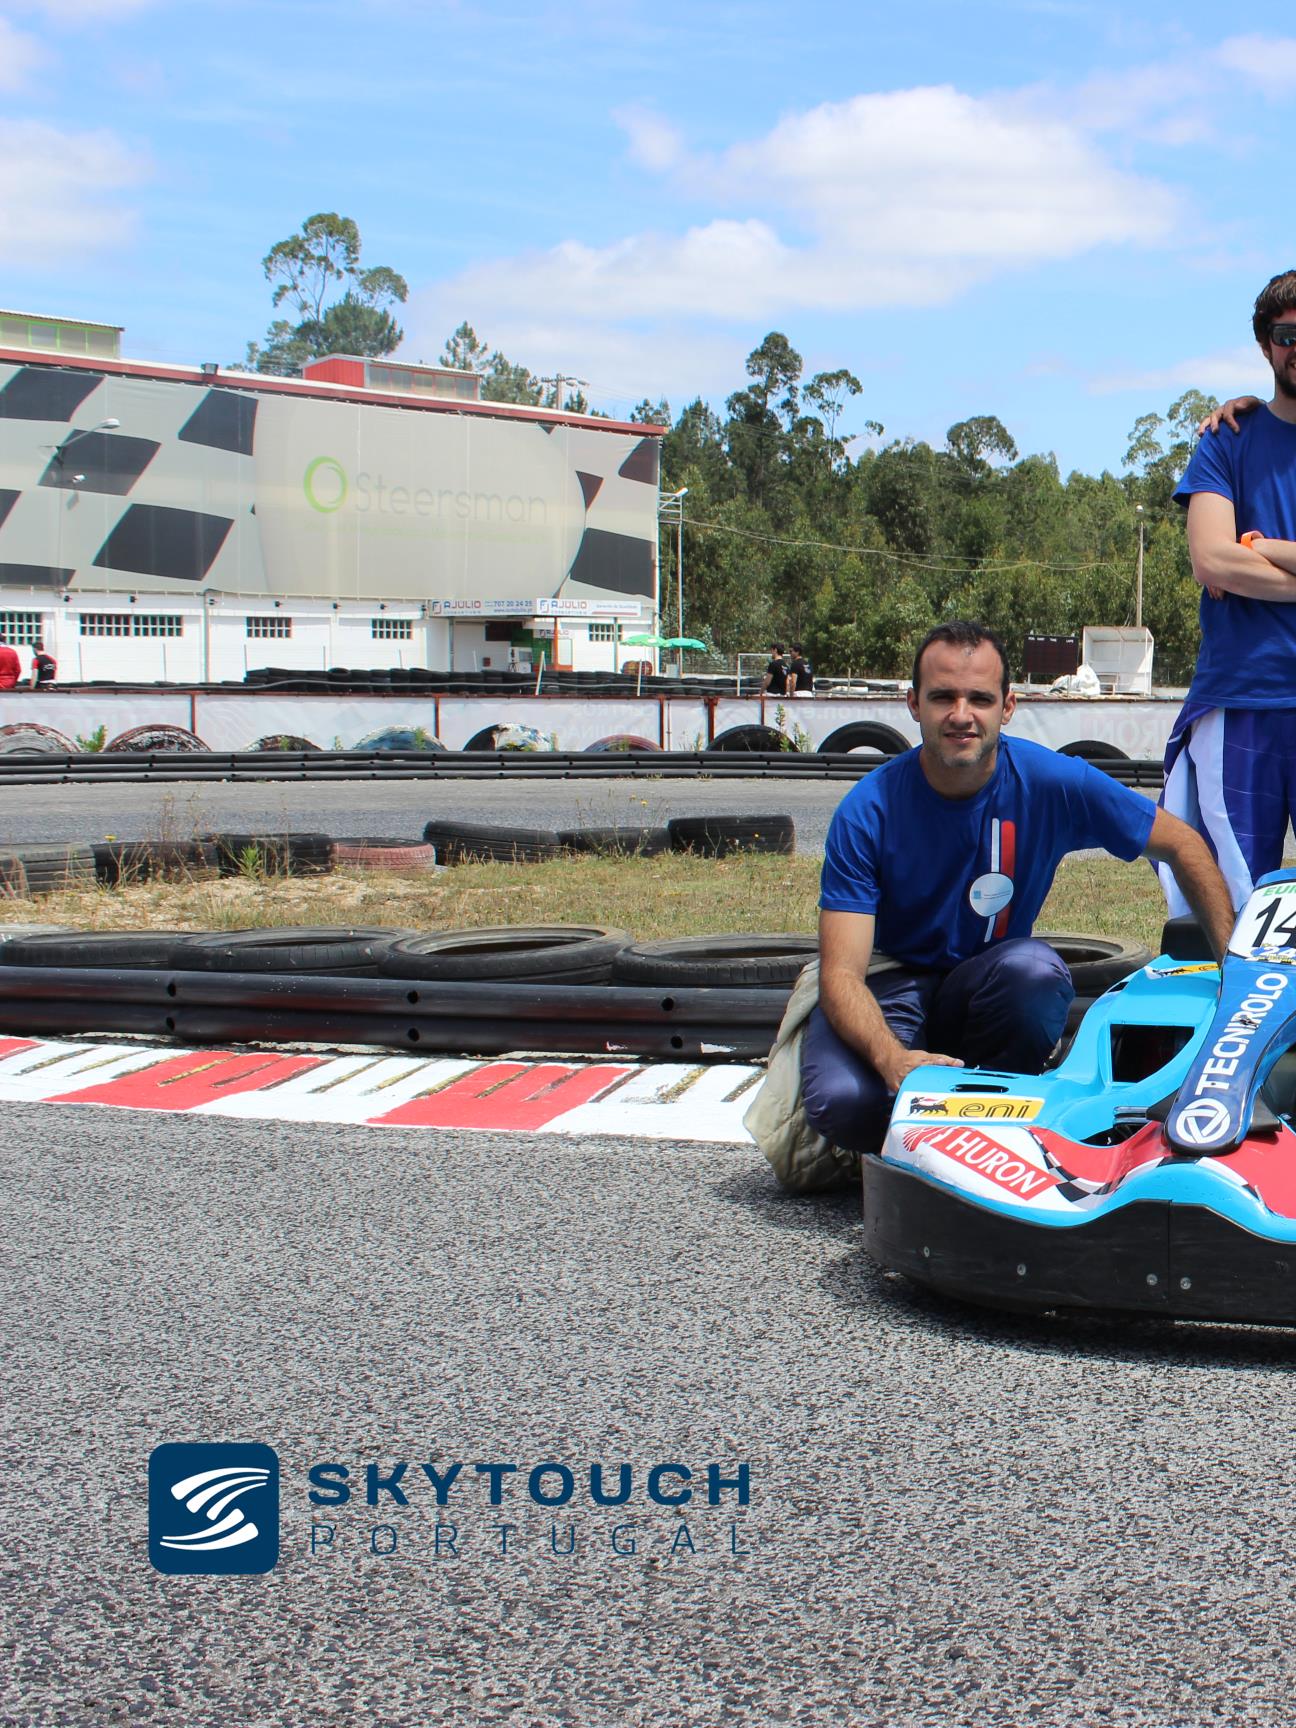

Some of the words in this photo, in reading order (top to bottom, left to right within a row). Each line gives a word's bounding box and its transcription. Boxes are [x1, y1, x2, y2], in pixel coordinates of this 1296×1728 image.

[355, 472, 547, 523] Steersman
[1195, 973, 1289, 1096] TECNIROLO
[958, 1100, 1033, 1119] eni
[945, 1130, 1047, 1193] HURON
